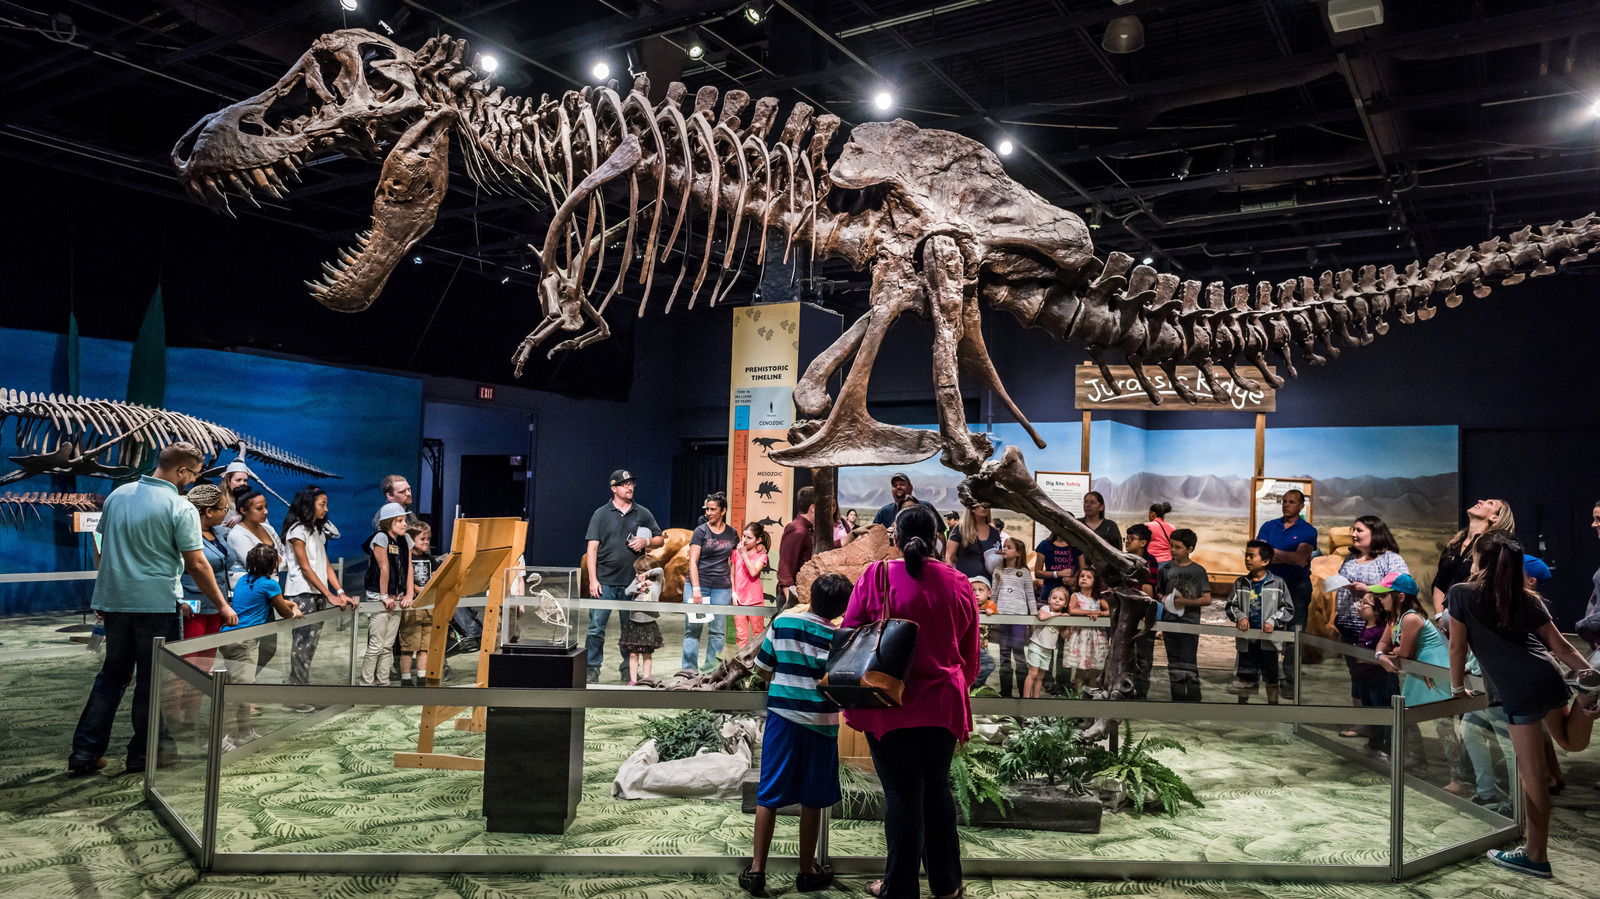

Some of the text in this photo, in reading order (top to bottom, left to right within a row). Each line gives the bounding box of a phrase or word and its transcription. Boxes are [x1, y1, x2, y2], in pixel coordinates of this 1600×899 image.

[745, 365, 789, 373] PREHISTORIC
[480, 387, 493, 399] EXIT
[1084, 375, 1190, 402] Jurasic
